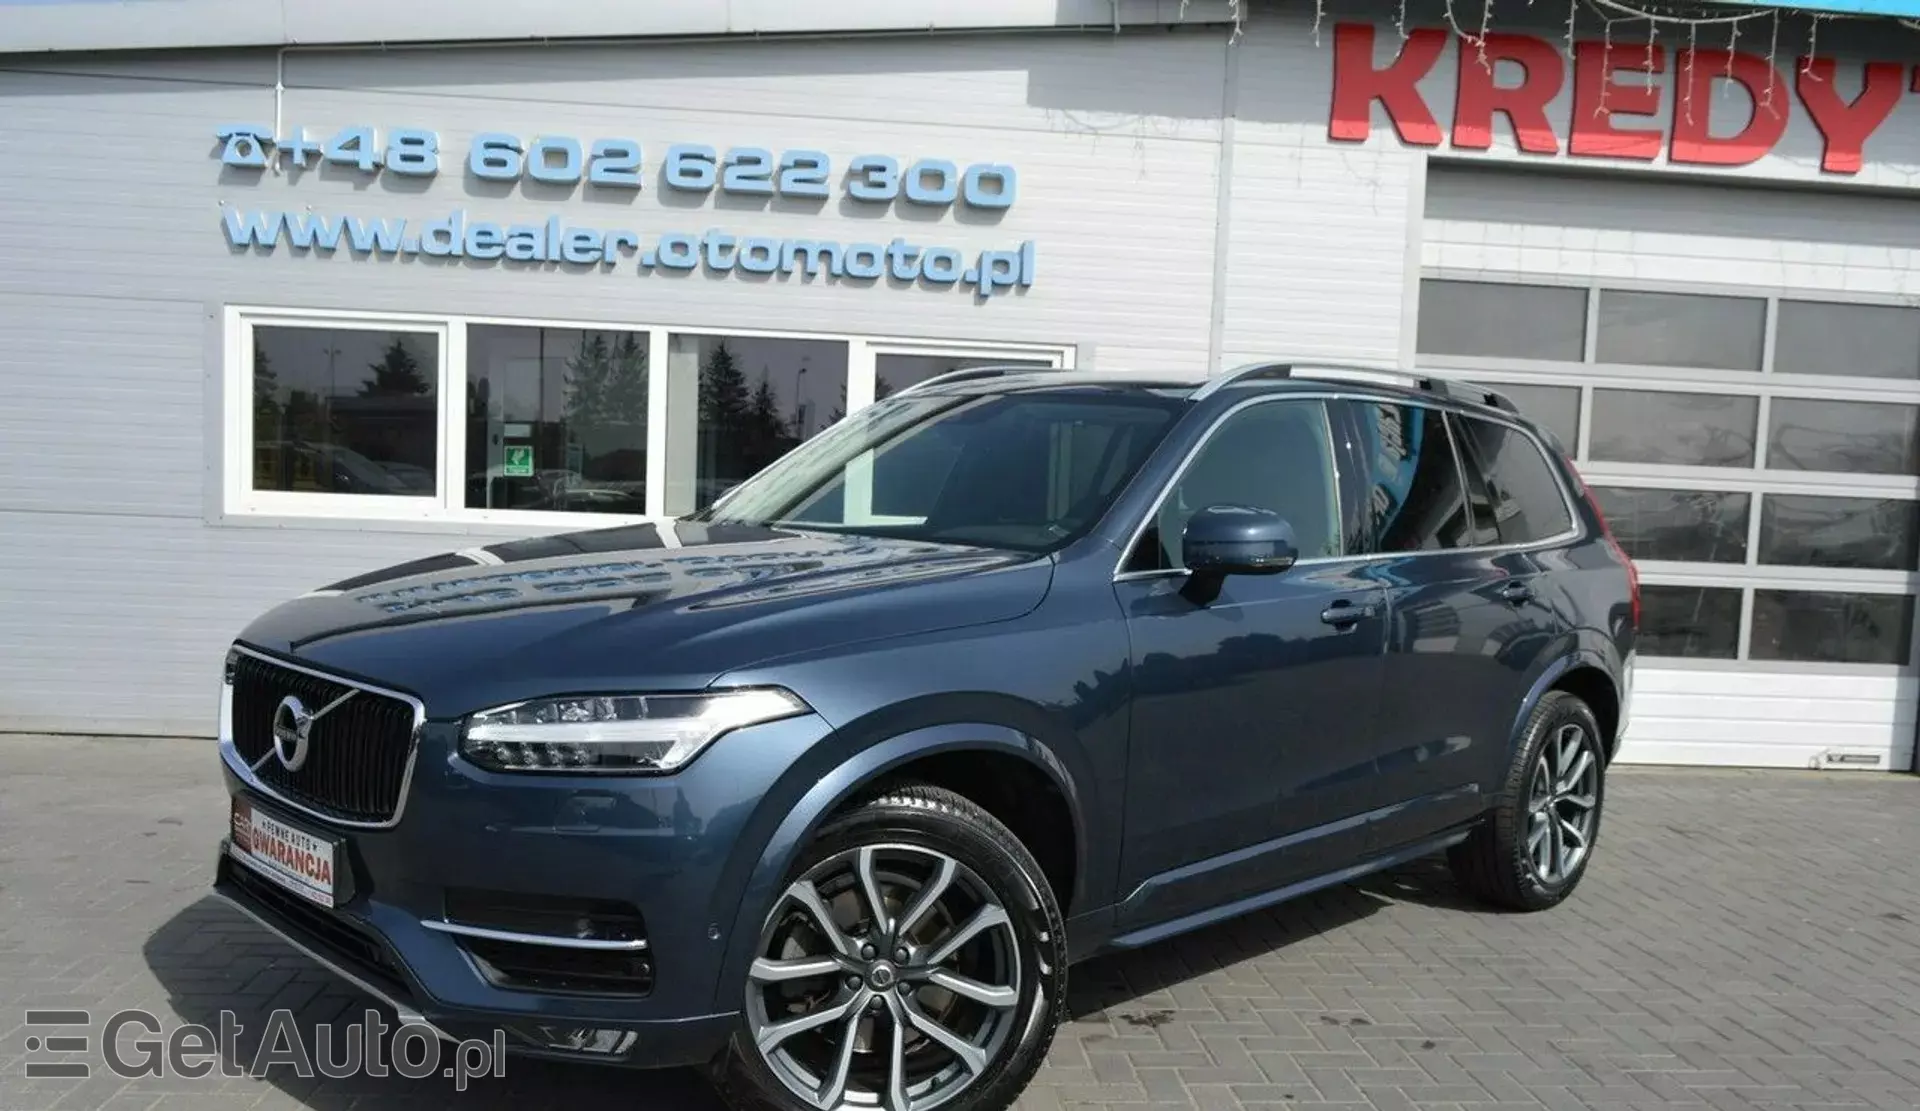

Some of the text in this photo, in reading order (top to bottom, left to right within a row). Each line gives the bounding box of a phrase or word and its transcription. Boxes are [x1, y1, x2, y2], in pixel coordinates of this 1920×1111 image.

[1328, 23, 1920, 173] KREDY
[278, 125, 1016, 209] +48 602 622 300
[221, 207, 1035, 297] www.dealer.otomoto.pl
[252, 826, 332, 885] GWARANCJA
